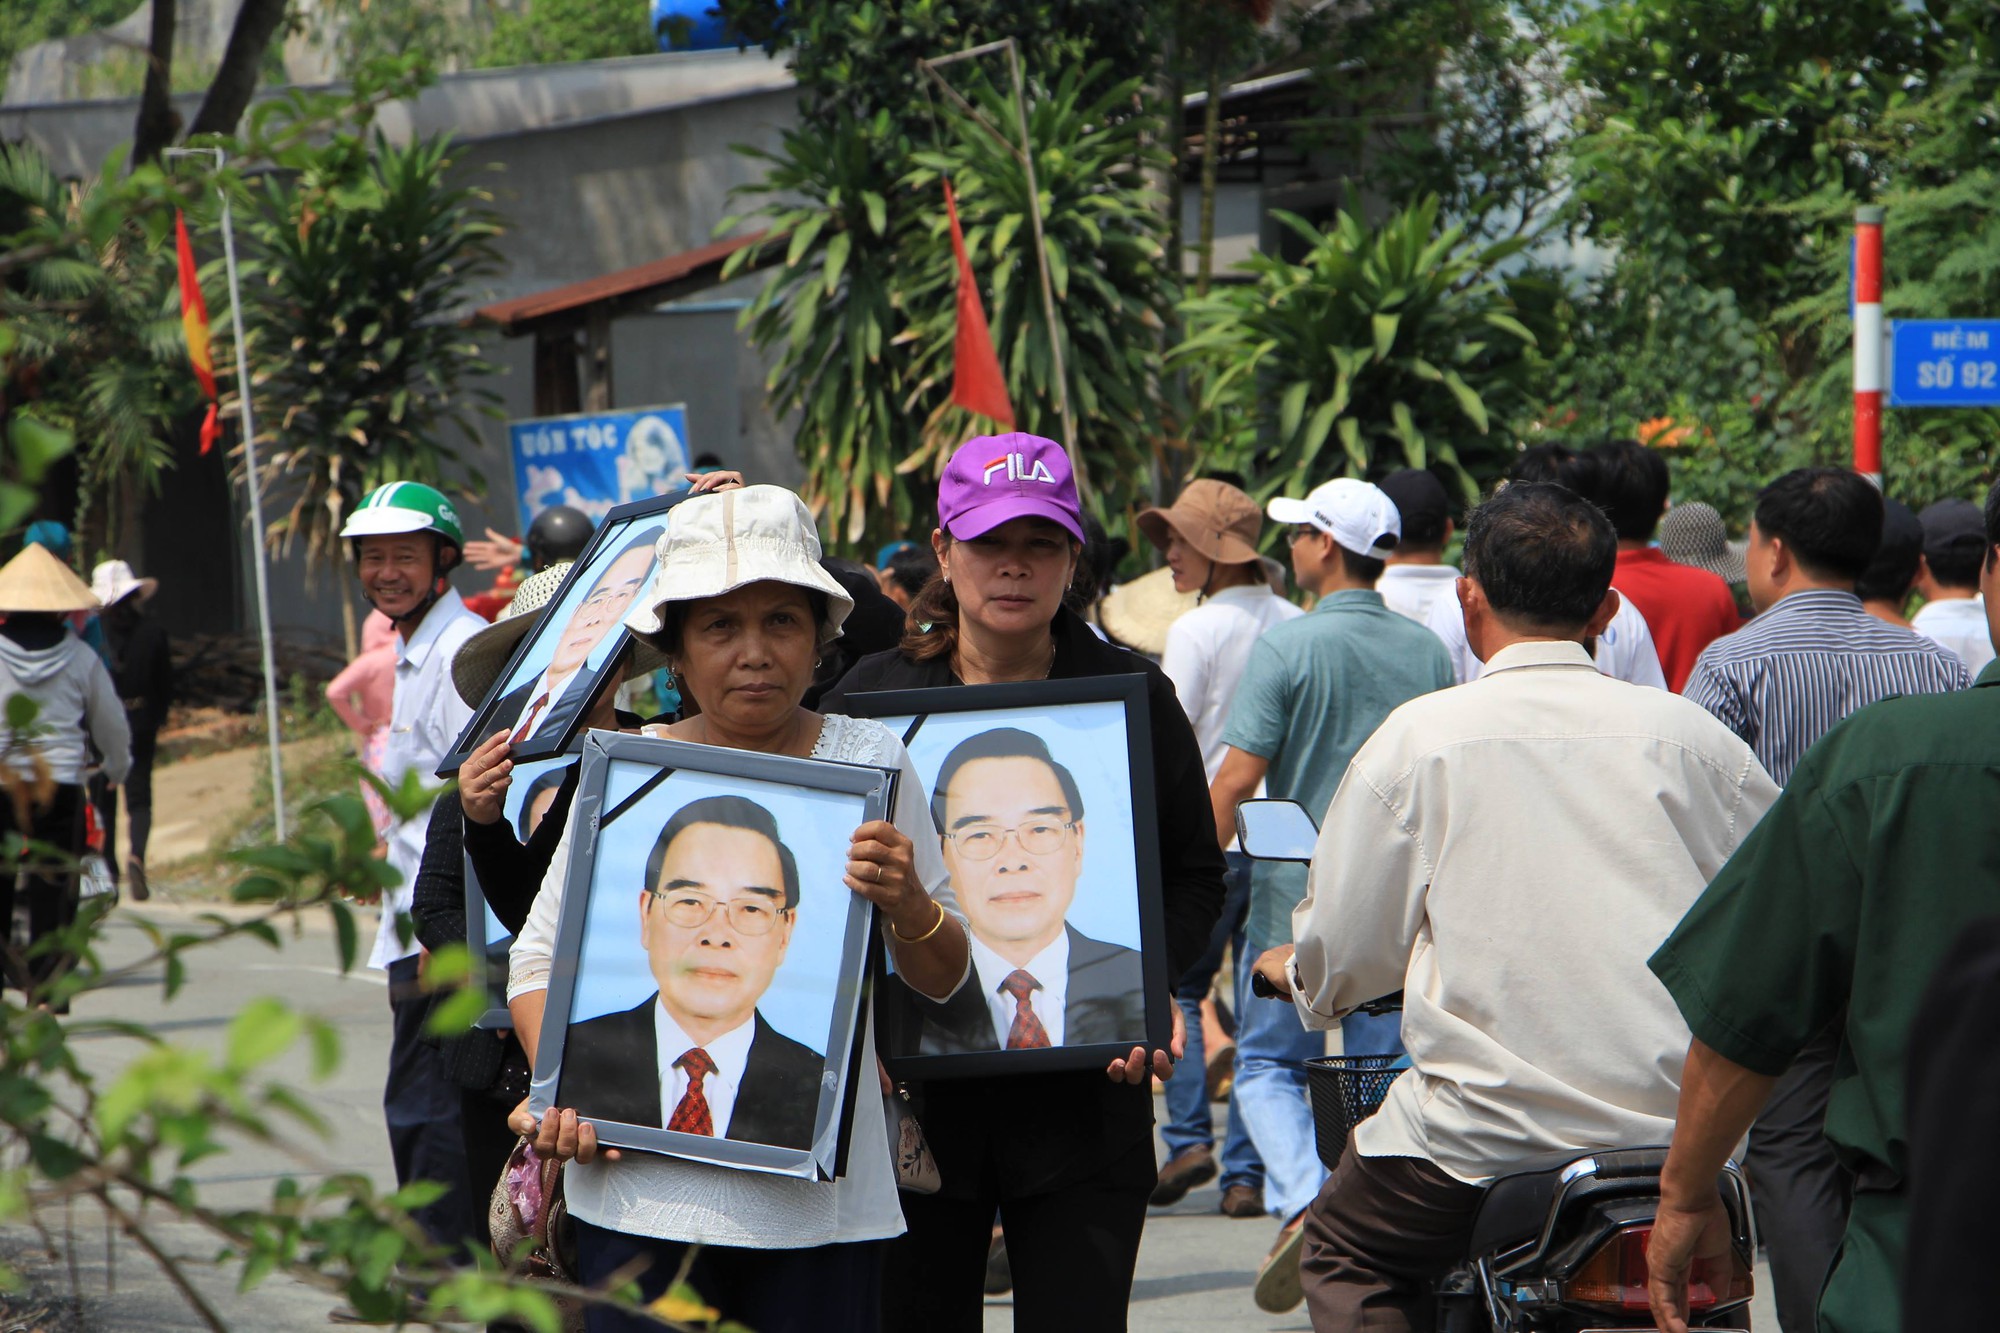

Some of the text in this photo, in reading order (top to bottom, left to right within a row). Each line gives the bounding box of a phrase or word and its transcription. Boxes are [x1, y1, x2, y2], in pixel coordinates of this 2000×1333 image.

[1917, 354, 1997, 389] SỐ 92
[983, 453, 1056, 486] FILA
